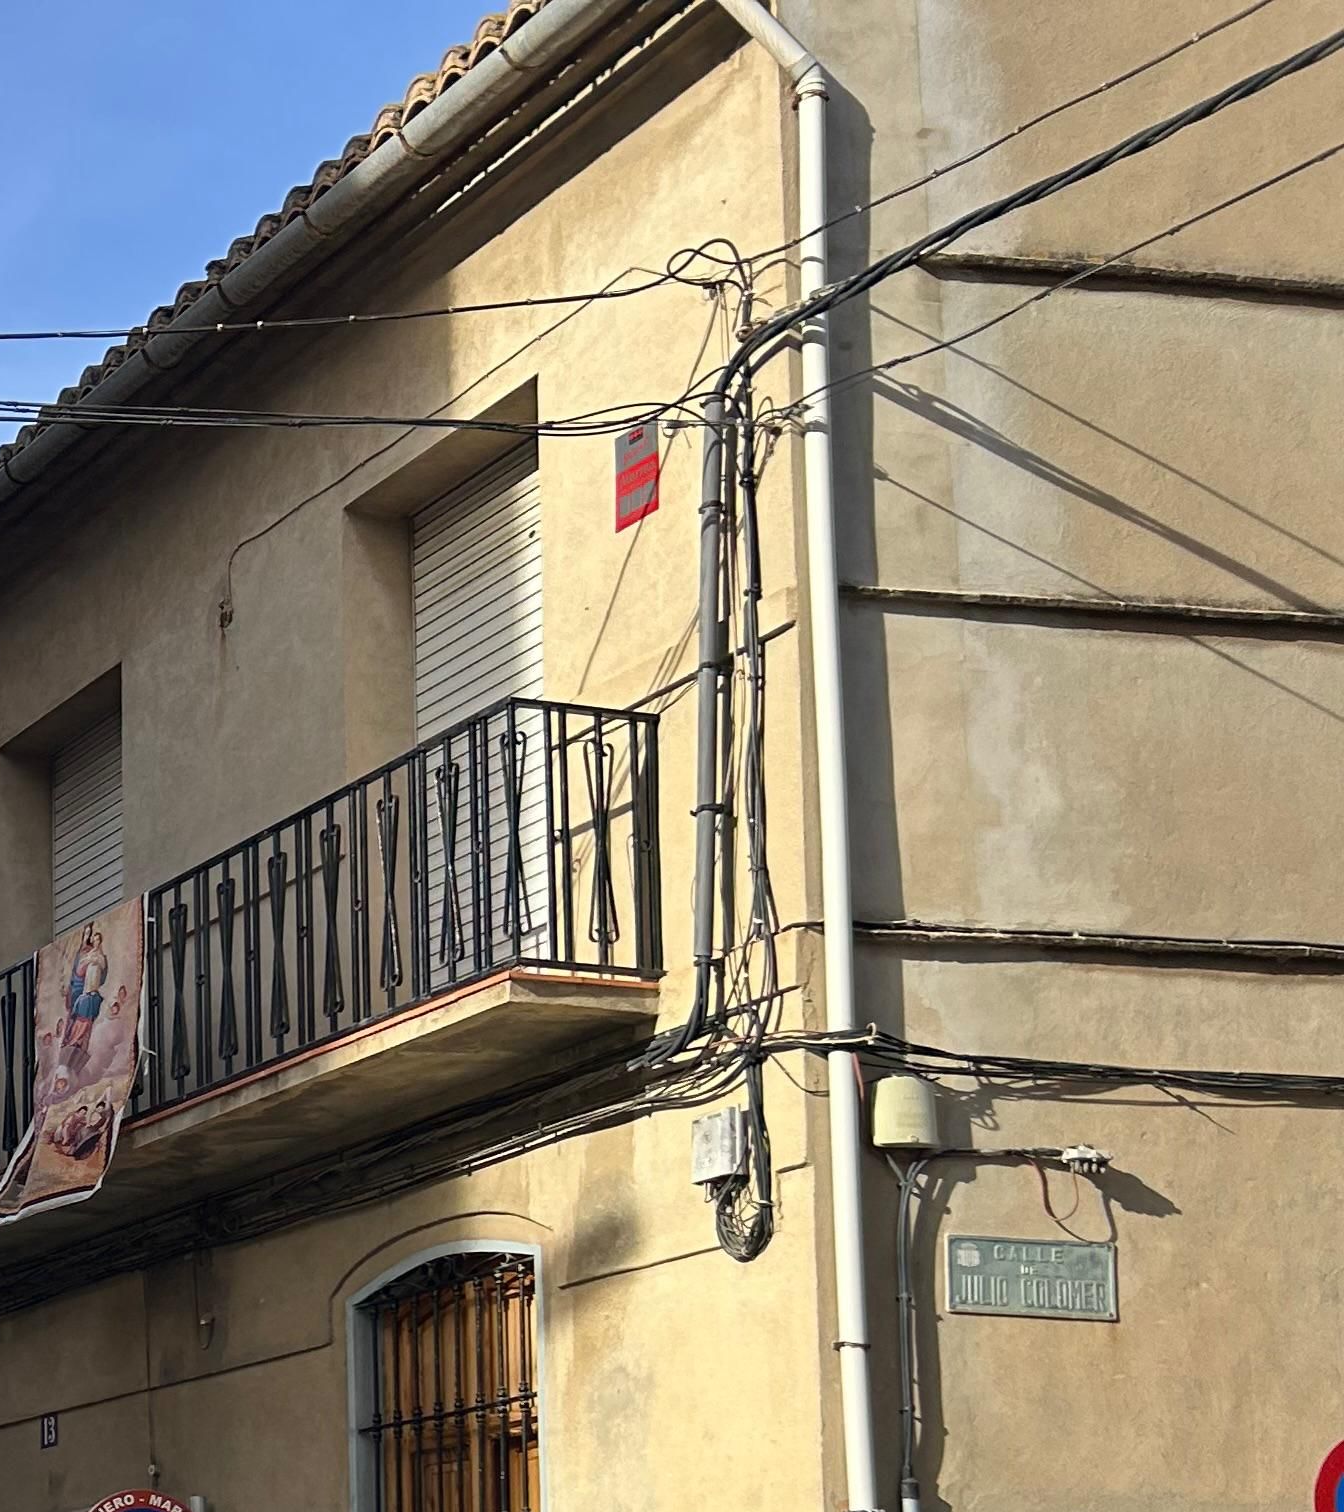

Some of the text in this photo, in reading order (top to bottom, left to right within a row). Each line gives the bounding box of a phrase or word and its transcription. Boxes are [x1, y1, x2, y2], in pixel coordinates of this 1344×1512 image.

[993, 1244, 1064, 1264] CALLE
[1020, 1264, 1039, 1276] DE
[956, 1275, 1106, 1312] JULIO COLOMER
[44, 1416, 56, 1445] 13
